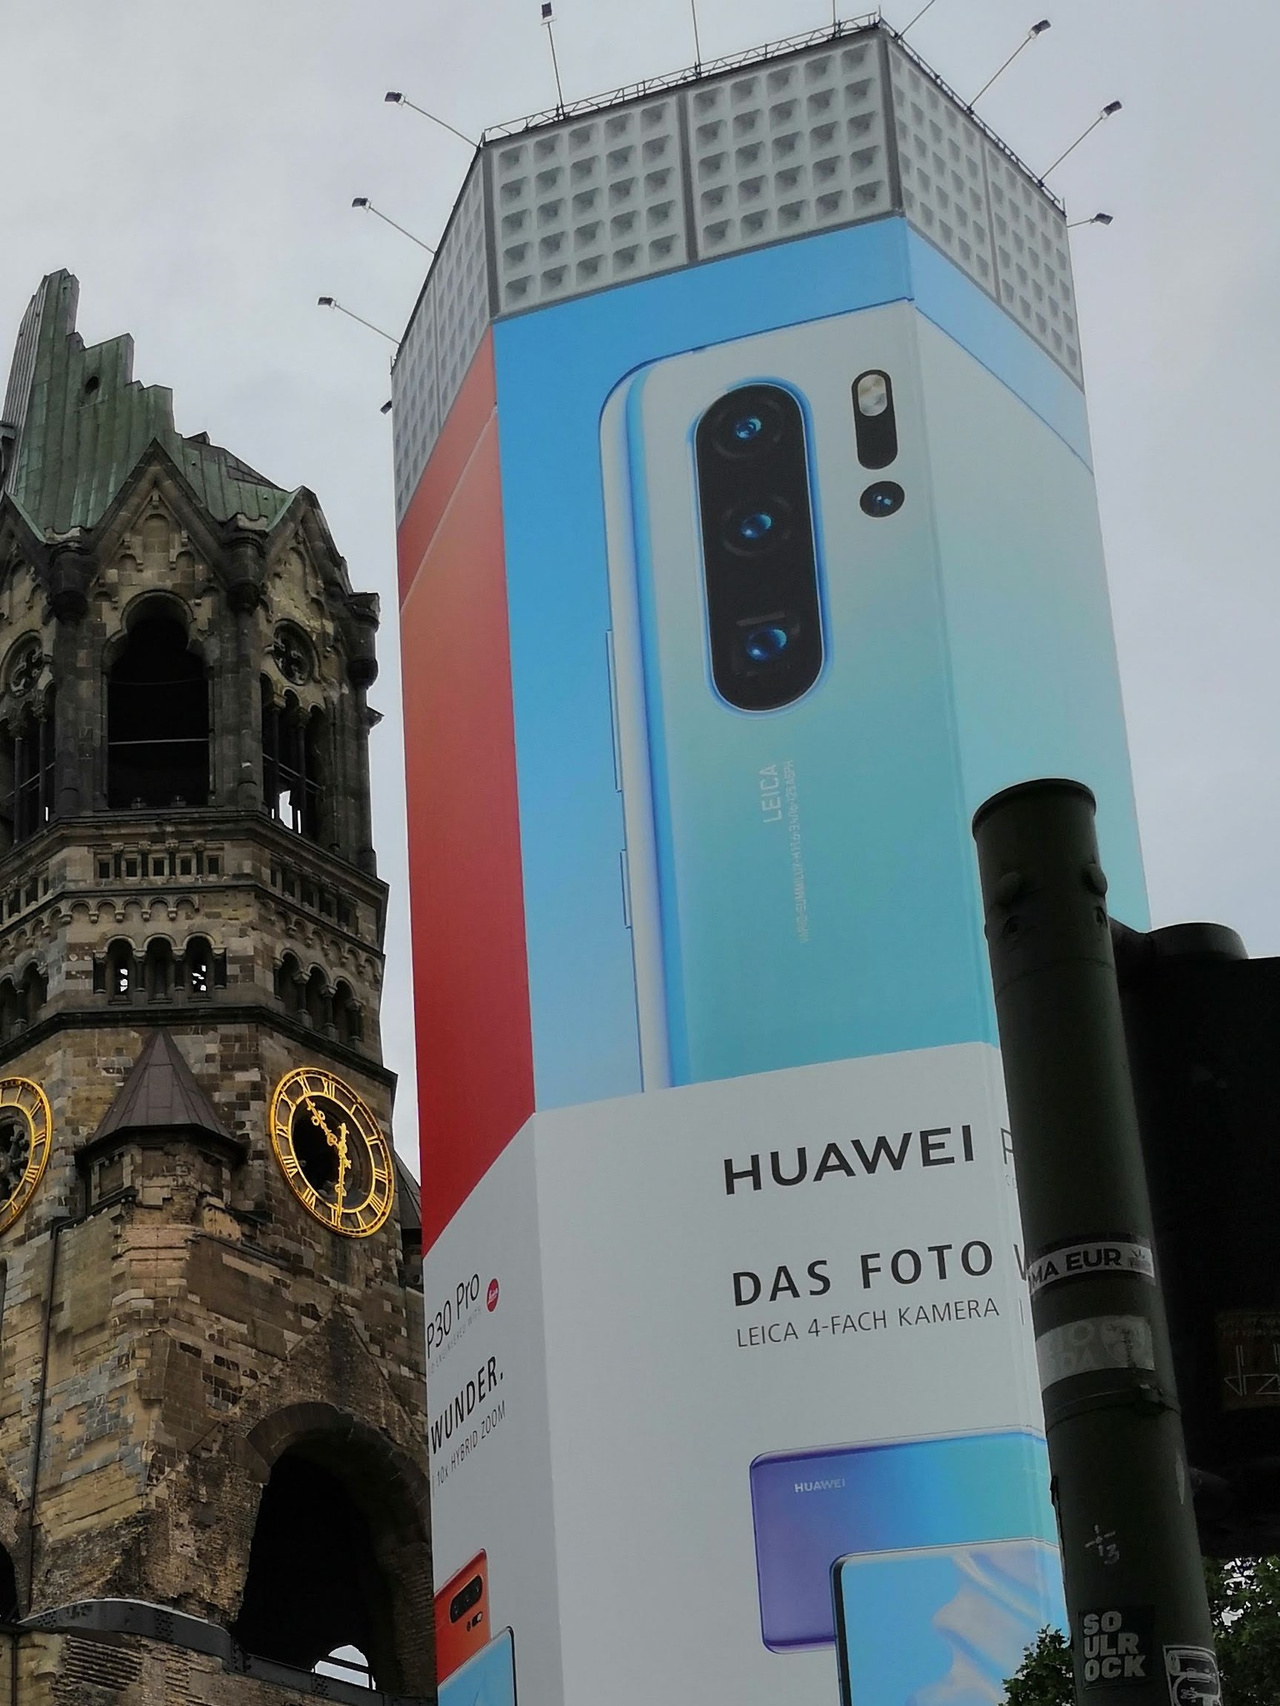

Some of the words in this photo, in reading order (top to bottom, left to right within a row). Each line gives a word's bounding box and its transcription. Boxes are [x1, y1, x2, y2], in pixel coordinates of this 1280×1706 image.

[759, 763, 783, 823] LEICA
[723, 1124, 975, 1196] HUAWEI
[732, 1259, 832, 1307] DAS
[859, 1240, 994, 1290] FOTO
[1065, 1247, 1123, 1272] EUR
[426, 1299, 452, 1359] P30
[456, 1273, 480, 1320] Pro
[736, 1321, 799, 1348] LEICA
[807, 1309, 888, 1338] 4-FACH
[897, 1296, 1000, 1327] KAMERA
[430, 1355, 504, 1455] WUNDER.
[450, 1430, 478, 1469] HYBRID
[480, 1399, 507, 1440] ZOOM
[794, 1477, 846, 1493] HUAWEI
[1083, 1610, 1123, 1636] SO
[1083, 1632, 1140, 1660] ULR
[1084, 1655, 1147, 1683] OCK
